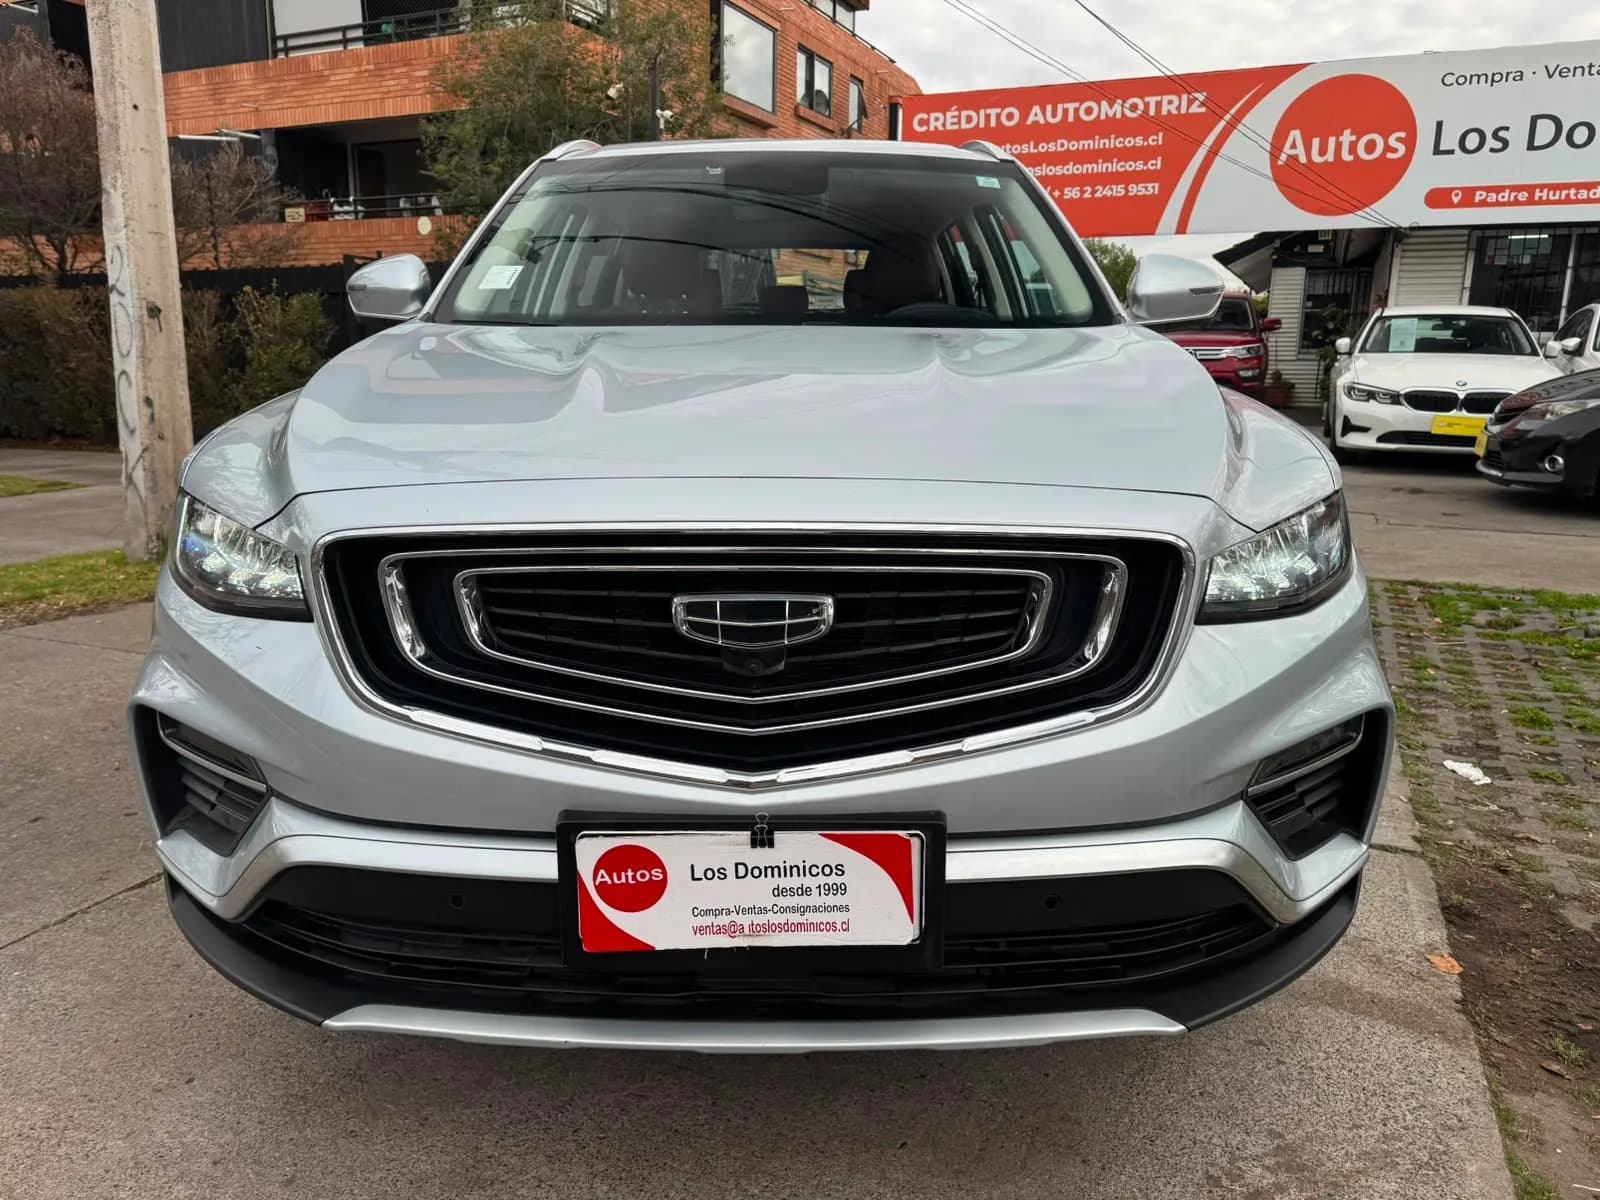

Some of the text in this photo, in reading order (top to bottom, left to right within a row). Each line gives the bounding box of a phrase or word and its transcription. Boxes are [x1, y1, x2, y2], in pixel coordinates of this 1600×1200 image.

[1441, 71, 1524, 88] Compra
[912, 92, 1207, 132] CRÉDITO AUTOMOTRIZ
[1432, 113, 1597, 156] Los Do
[1277, 129, 1407, 165] Autos
[1063, 187, 1081, 199] 56
[1083, 186, 1092, 198] 2
[1094, 185, 1125, 198] 2415
[1128, 183, 1159, 196] 9531
[1474, 189, 1528, 203] Padre
[595, 866, 664, 886] Autos
[690, 860, 846, 882] Los Dominicos
[771, 882, 848, 898] desde 1999
[691, 902, 850, 918] Compra-Ventas-Consignaciones
